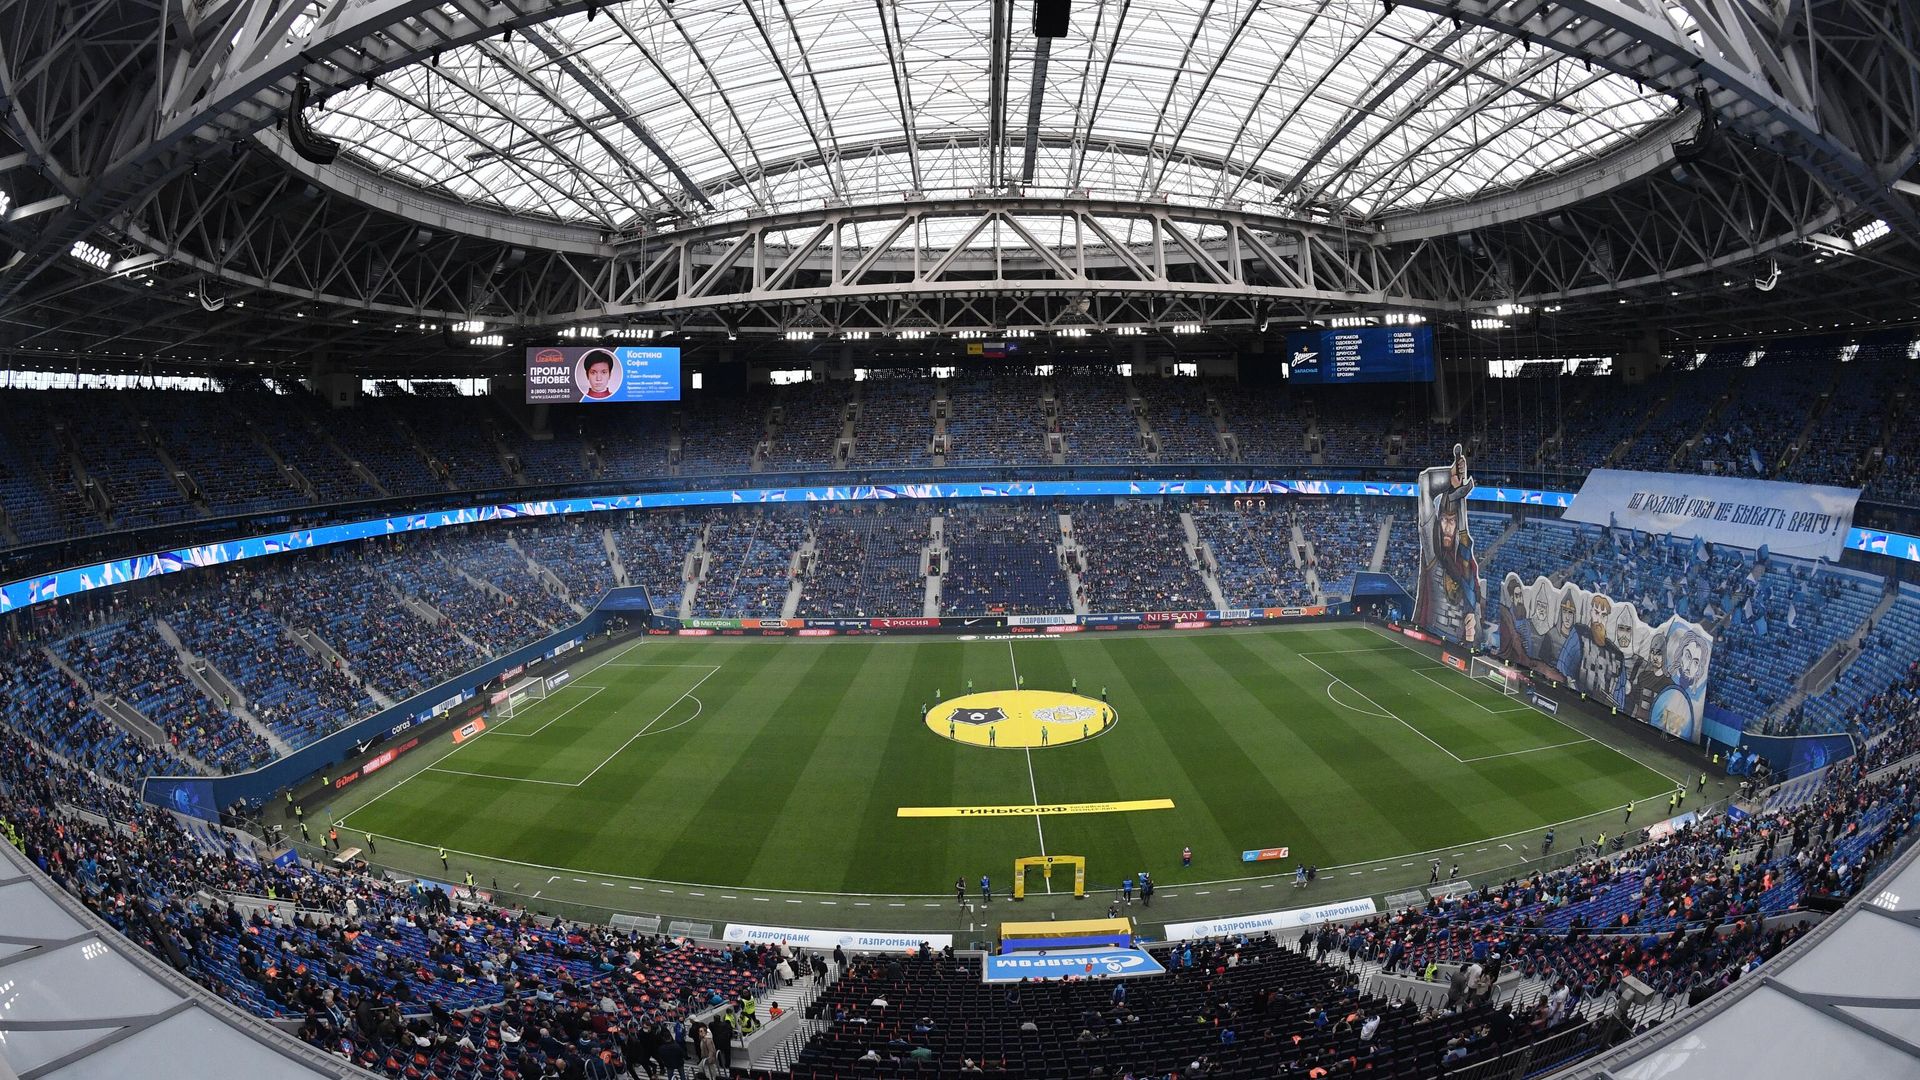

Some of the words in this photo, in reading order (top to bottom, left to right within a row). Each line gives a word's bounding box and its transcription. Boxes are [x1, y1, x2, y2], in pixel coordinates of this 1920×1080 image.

[626, 350, 662, 359] Костина
[530, 366, 570, 376] ПРОПАЛ
[530, 376, 570, 384] ЧЕЛОВЕК
[1627, 493, 1646, 510] НА
[1642, 493, 1689, 516] РОДНОЙ
[1683, 498, 1716, 519] РУСИ
[1713, 502, 1735, 522] НЕ
[1731, 504, 1787, 530] БЫВАТЬ
[1147, 612, 1198, 620] NISSAN
[956, 806, 1067, 815] ТИНЬКОФФ
[1316, 903, 1371, 919] ГАЗПРОМБАНК
[1213, 918, 1274, 933] ГАЗПРОМБАНК
[747, 930, 810, 943] ГАЗПРОМБАНК
[858, 937, 924, 947] ГАЗПРОМБАНК
[996, 957, 1100, 968] ГАЗПРОМ
